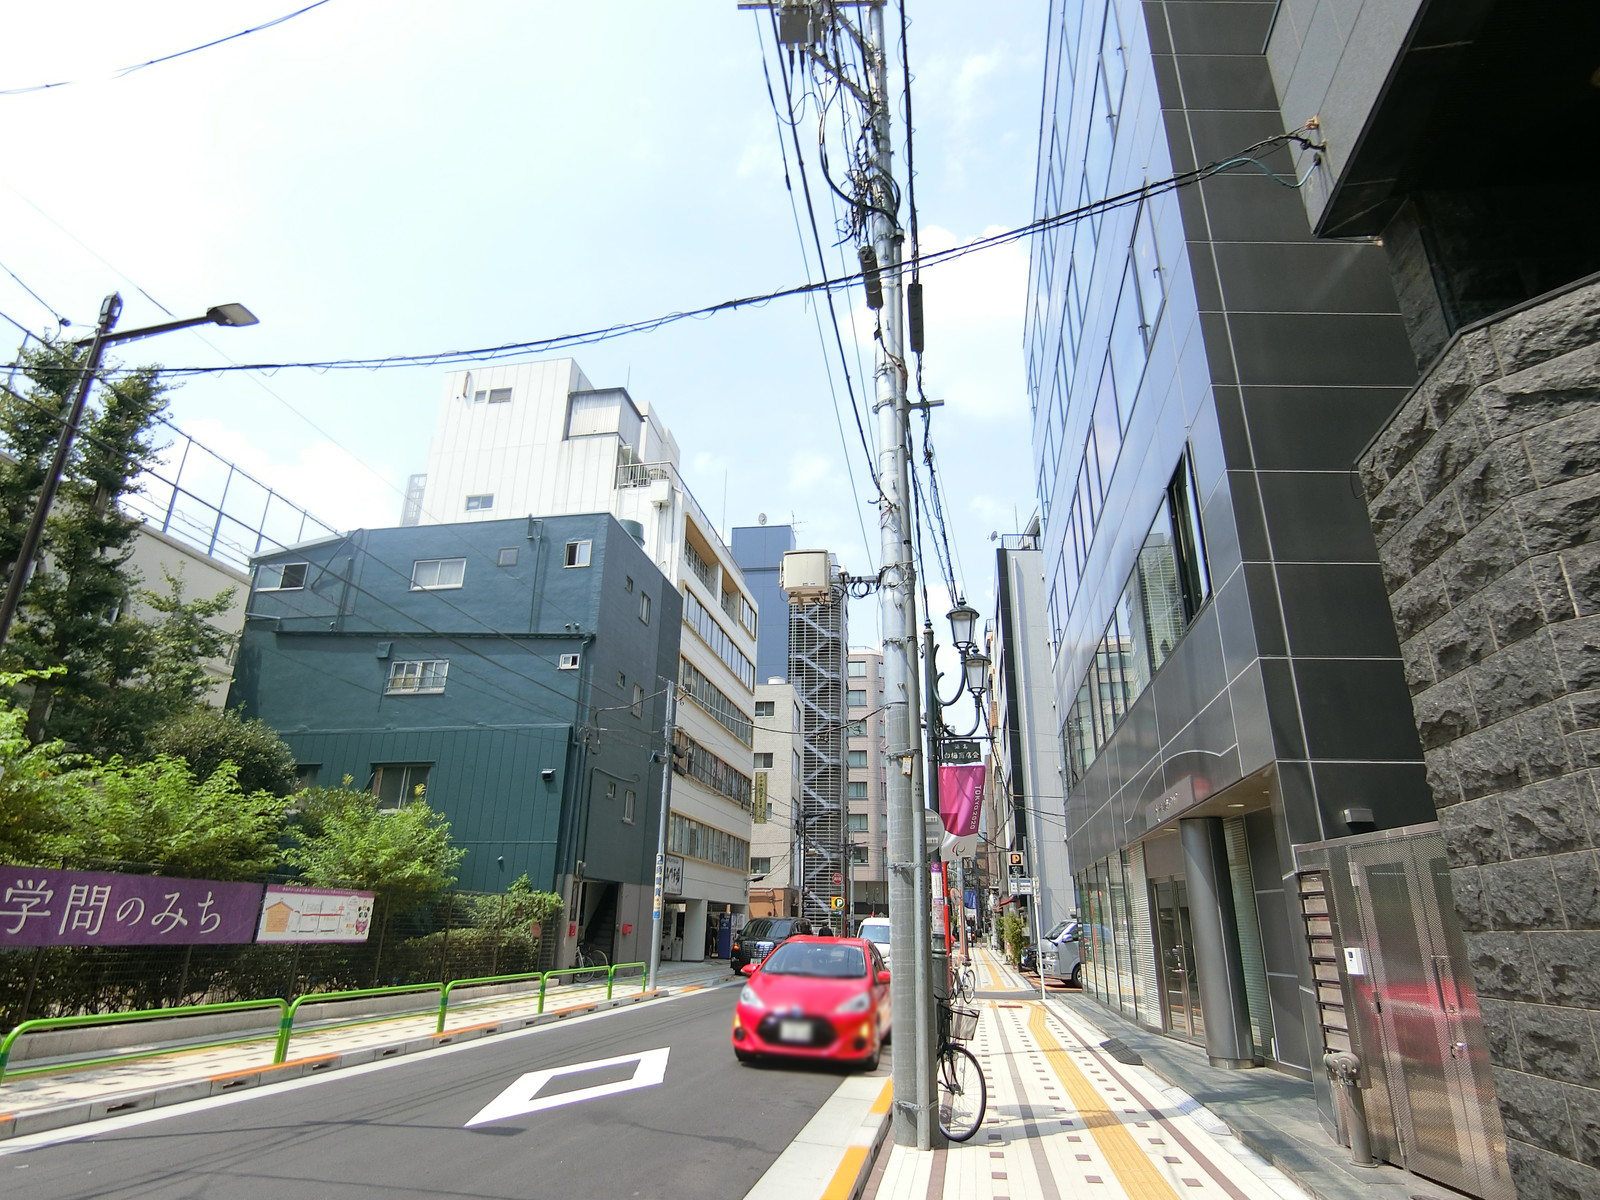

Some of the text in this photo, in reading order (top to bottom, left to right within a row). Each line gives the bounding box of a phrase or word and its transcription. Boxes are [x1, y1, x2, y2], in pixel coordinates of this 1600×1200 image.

[969, 785, 982, 830] TOKYO 2020
[1012, 855, 1020, 863] P
[0, 879, 221, 936] 学問のみち
